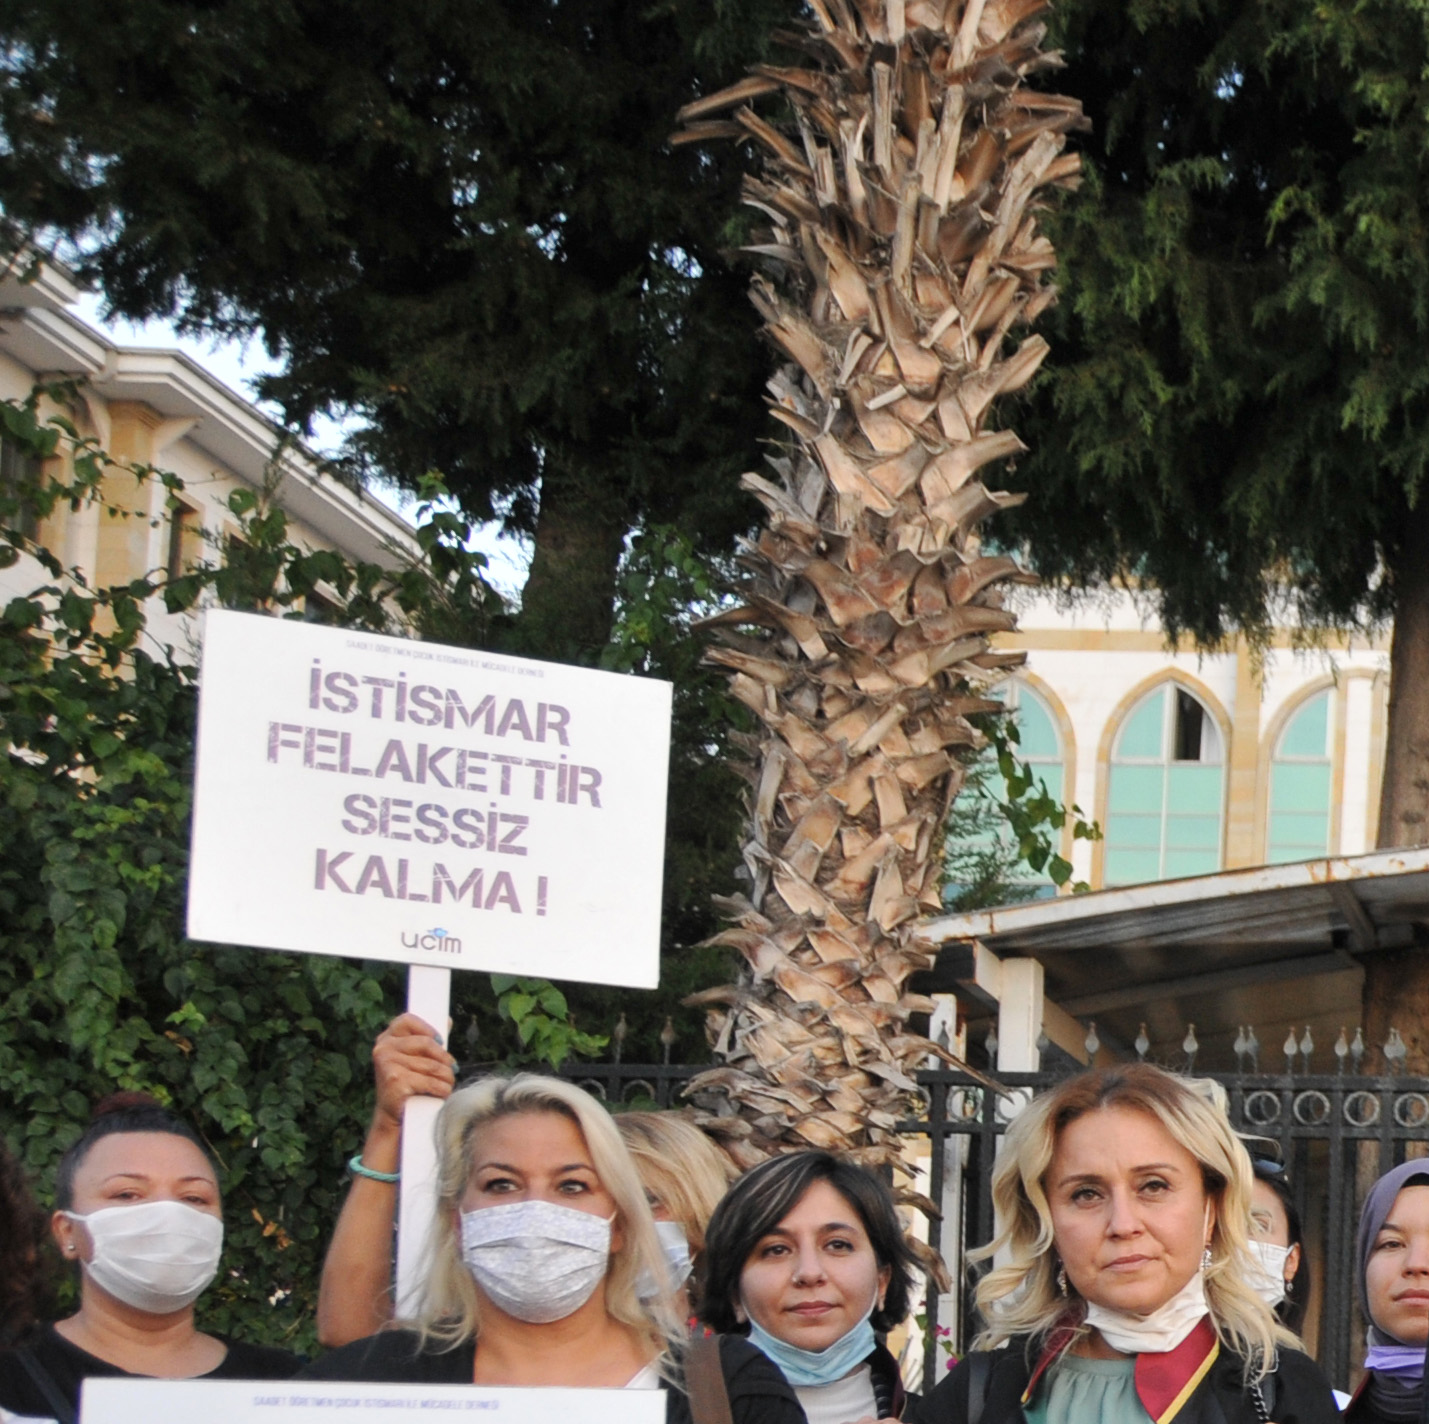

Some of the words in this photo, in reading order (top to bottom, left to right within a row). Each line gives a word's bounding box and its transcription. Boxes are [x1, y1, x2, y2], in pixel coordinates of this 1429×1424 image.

[308, 658, 571, 747] İSTİSMAR
[267, 721, 603, 808] FELAKETTİR
[342, 793, 529, 856] SESSİZ
